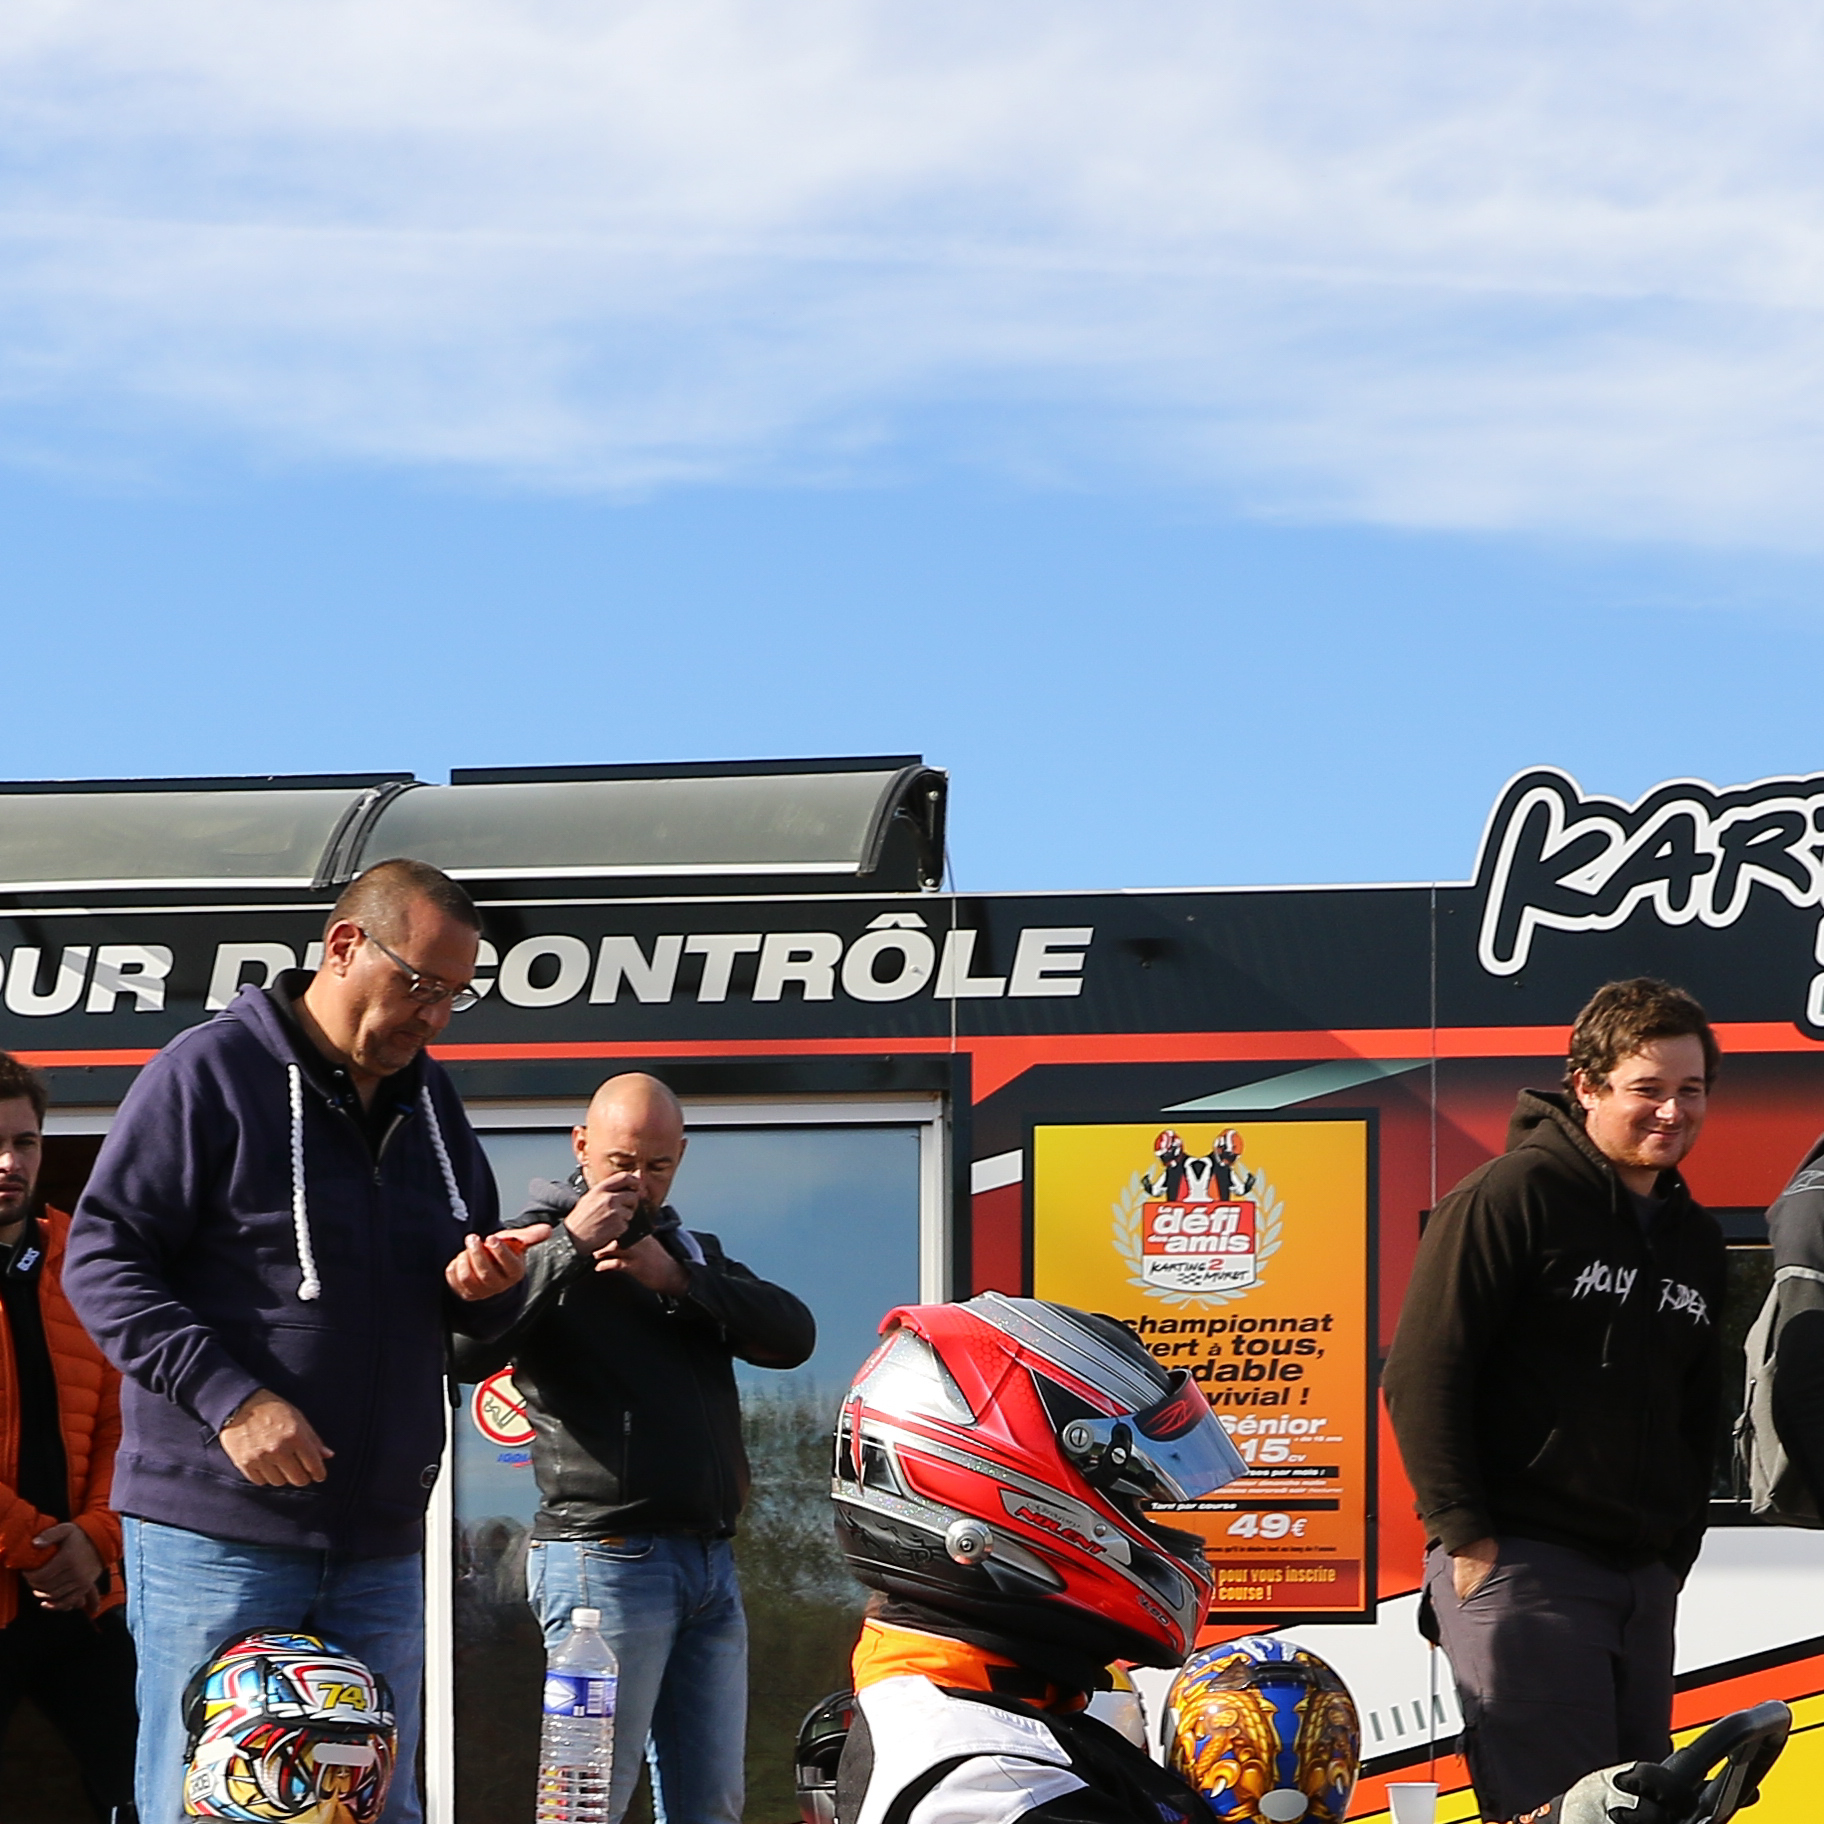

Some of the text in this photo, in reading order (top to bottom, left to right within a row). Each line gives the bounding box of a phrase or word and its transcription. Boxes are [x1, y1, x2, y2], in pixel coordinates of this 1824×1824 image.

[205, 942, 324, 1011] D
[1152, 1206, 1241, 1235] défi
[1164, 1232, 1251, 1253] amis
[1207, 1258, 1225, 1271] 2
[1142, 1338, 1200, 1357] vert
[1231, 1335, 1325, 1359] tous,
[1161, 1360, 1304, 1382] rdable
[1206, 1387, 1290, 1407] vivial
[1219, 1415, 1327, 1435] Sénior
[1176, 1502, 1196, 1511] par
[1197, 1502, 1238, 1510] course
[1219, 1565, 1336, 1586] pour vous inscrire
[1219, 1587, 1264, 1600] course
[318, 1682, 367, 1711] 74
